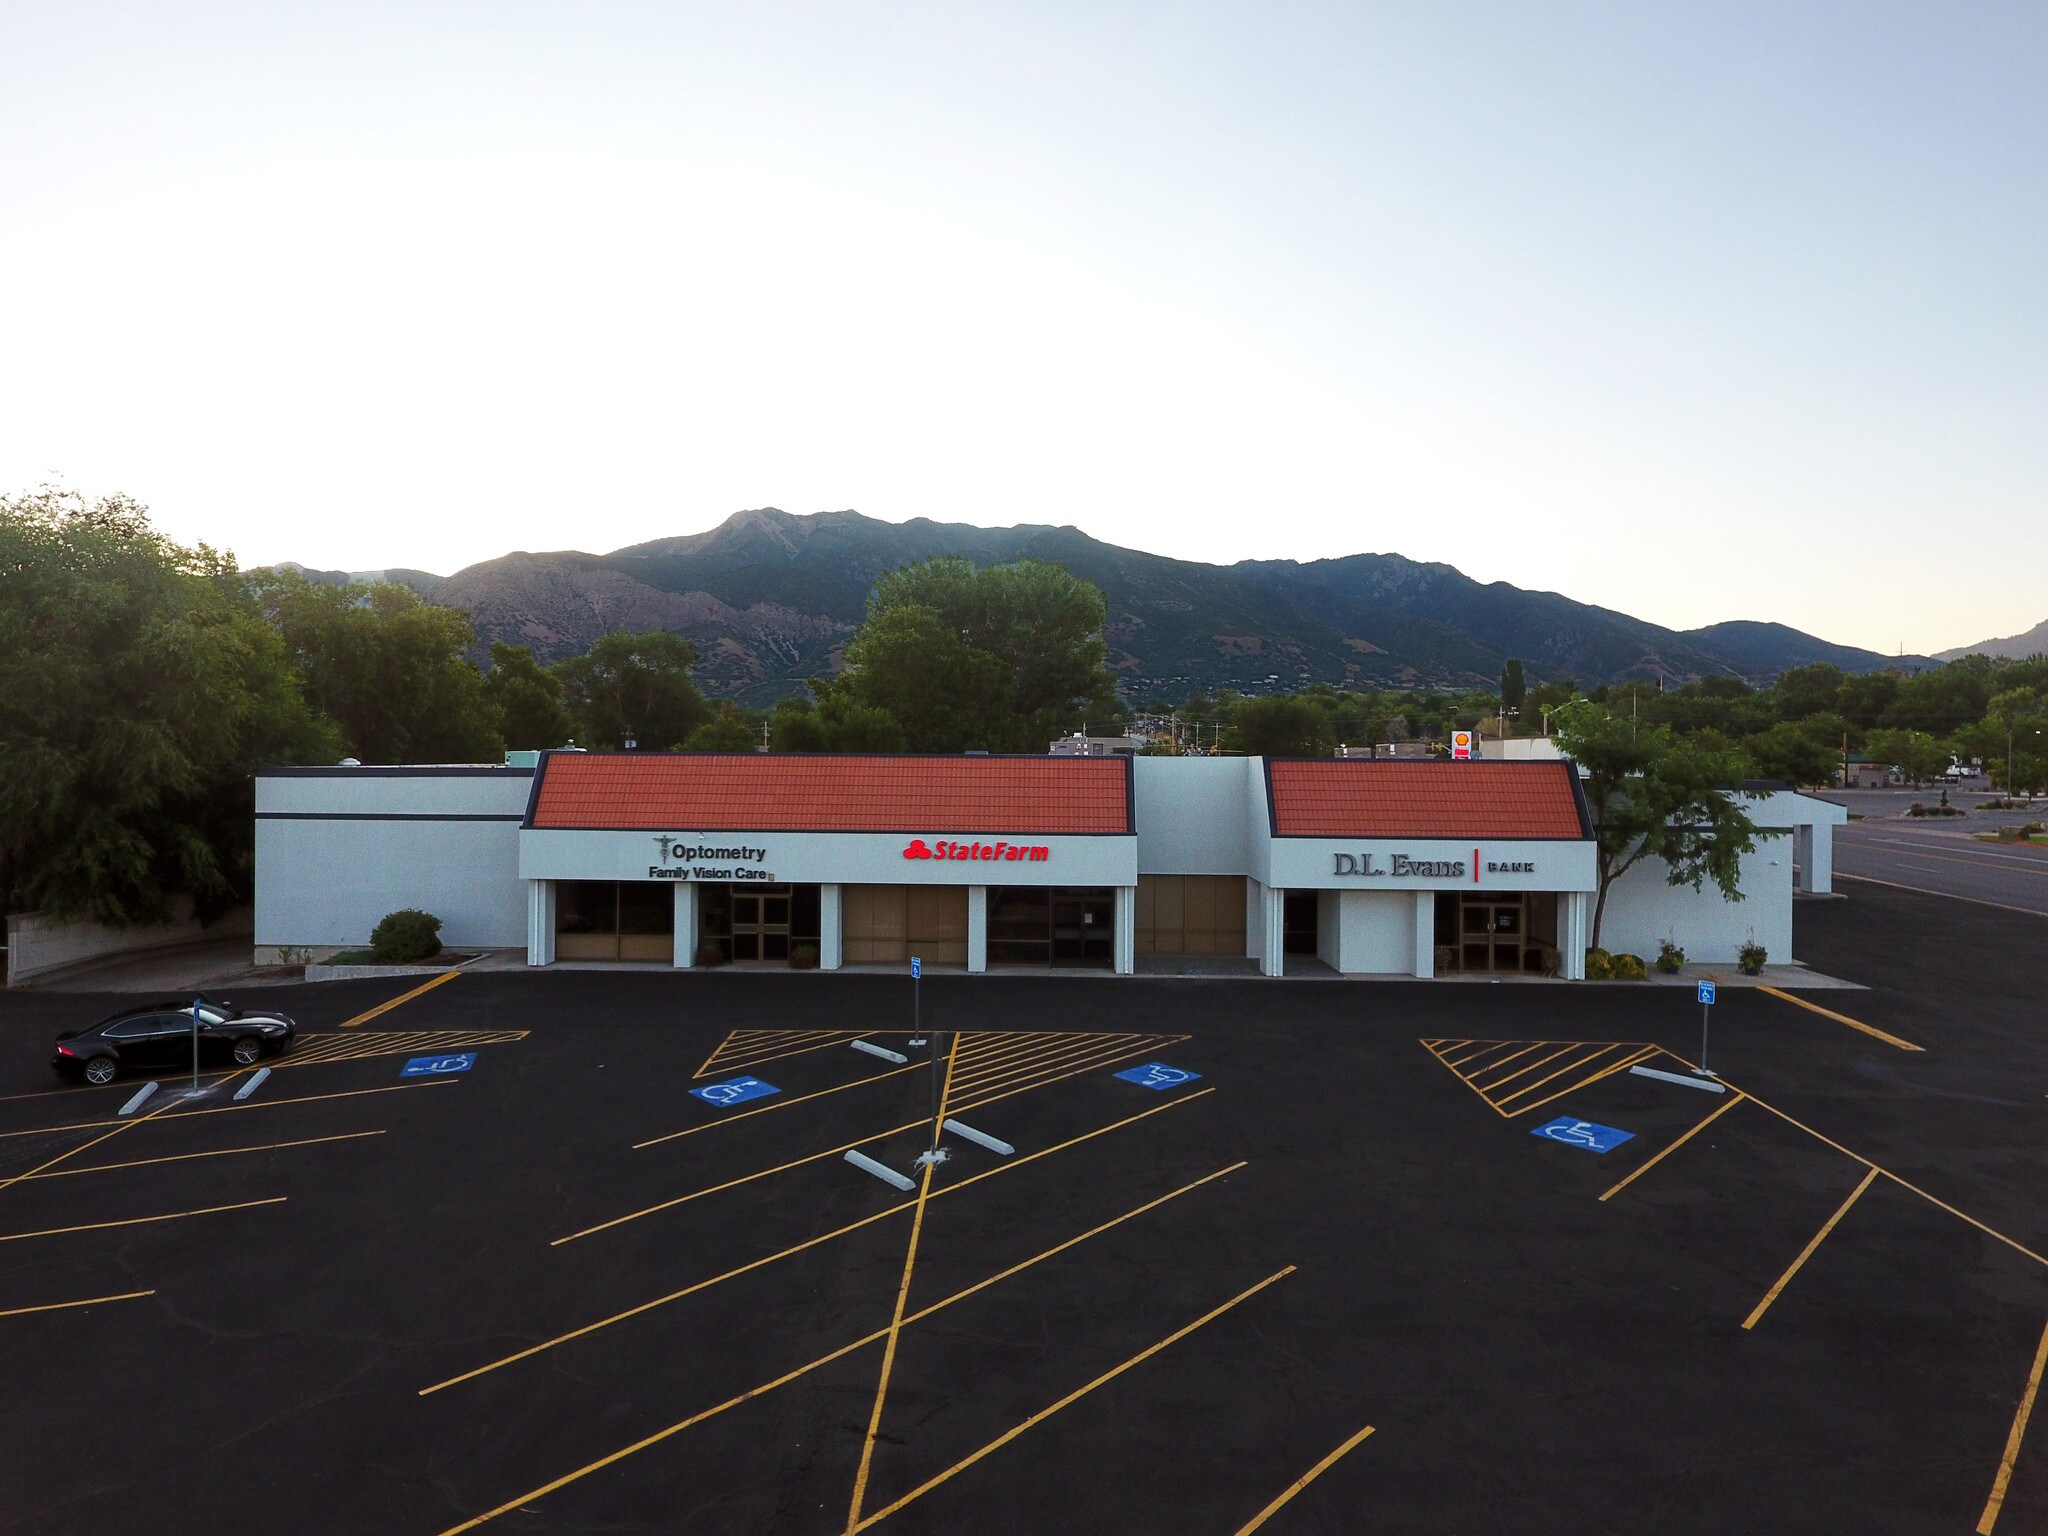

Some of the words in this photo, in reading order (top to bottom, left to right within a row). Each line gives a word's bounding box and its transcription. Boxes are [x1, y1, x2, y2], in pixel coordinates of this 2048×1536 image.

[672, 844, 766, 862] Optometry
[649, 866, 689, 880] Family
[693, 866, 731, 879] Vision
[735, 867, 767, 880] Care
[1333, 853, 1386, 876] D.L.
[1391, 853, 1465, 877] Evans
[1487, 861, 1535, 873] BANK
